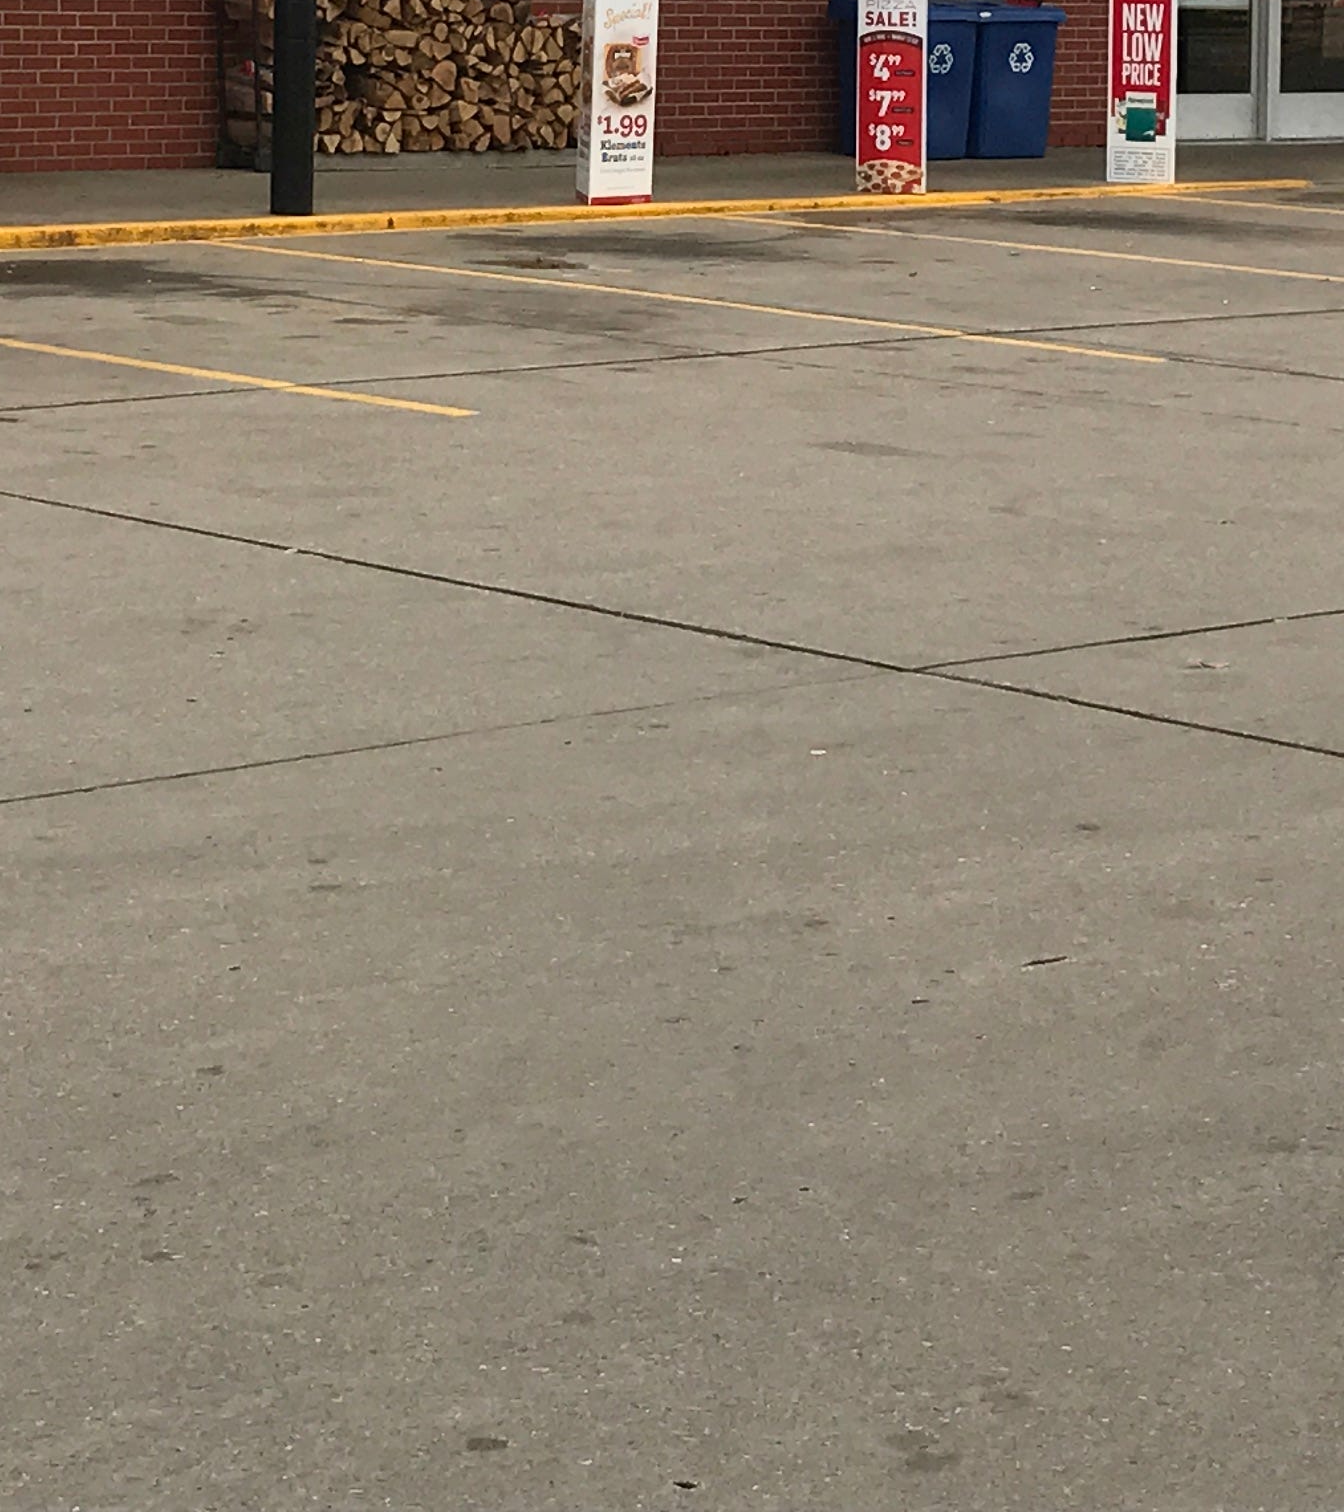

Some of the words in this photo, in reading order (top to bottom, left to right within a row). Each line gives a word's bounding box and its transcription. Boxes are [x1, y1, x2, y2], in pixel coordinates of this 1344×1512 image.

[866, 0, 917, 9] PIZZA
[865, 11, 917, 27] SALE!
[1122, 2, 1164, 32] NEW
[1122, 32, 1164, 62] LOW
[1121, 63, 1162, 86] PRICE
[597, 114, 648, 138] $1.99
